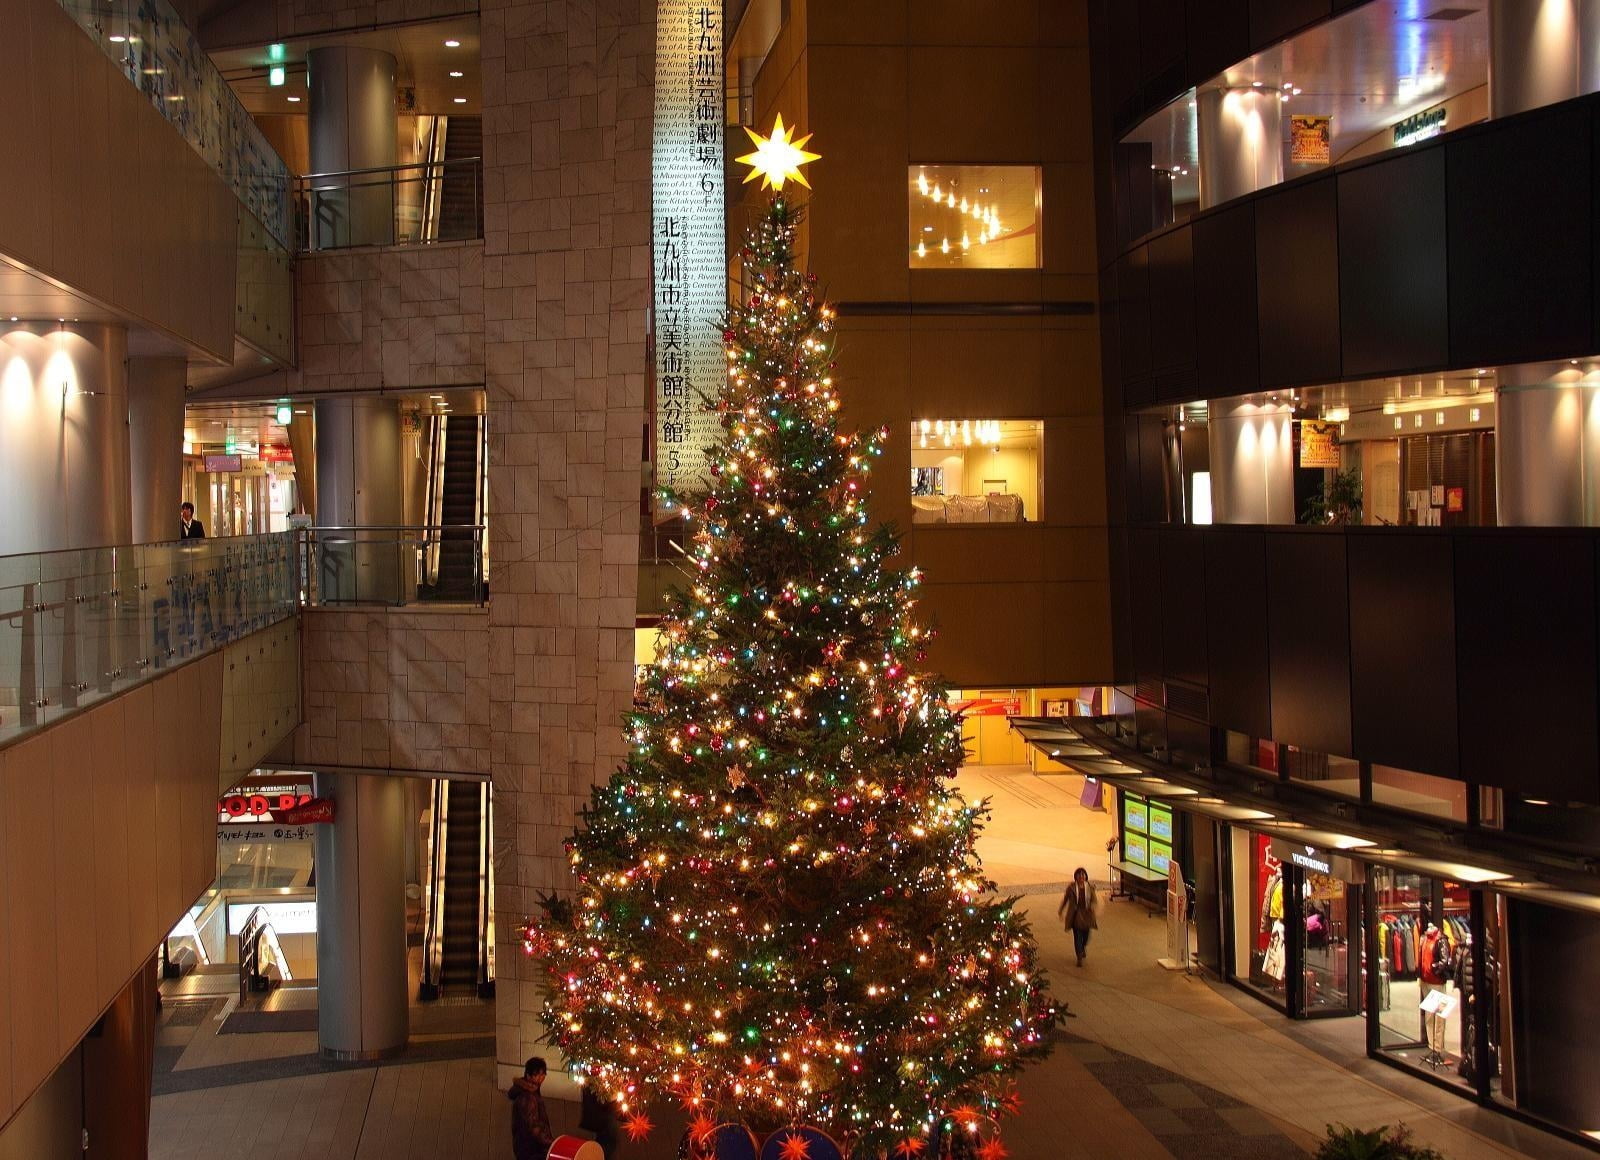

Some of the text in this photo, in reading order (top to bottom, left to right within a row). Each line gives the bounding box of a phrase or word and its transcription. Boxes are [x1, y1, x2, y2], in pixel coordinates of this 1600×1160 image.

[696, 8, 717, 166] 北九州芸術劇場
[660, 216, 683, 443] 北九州市立美術館分館
[218, 795, 270, 816] OD
[1292, 853, 1330, 874] VICTORINOX
